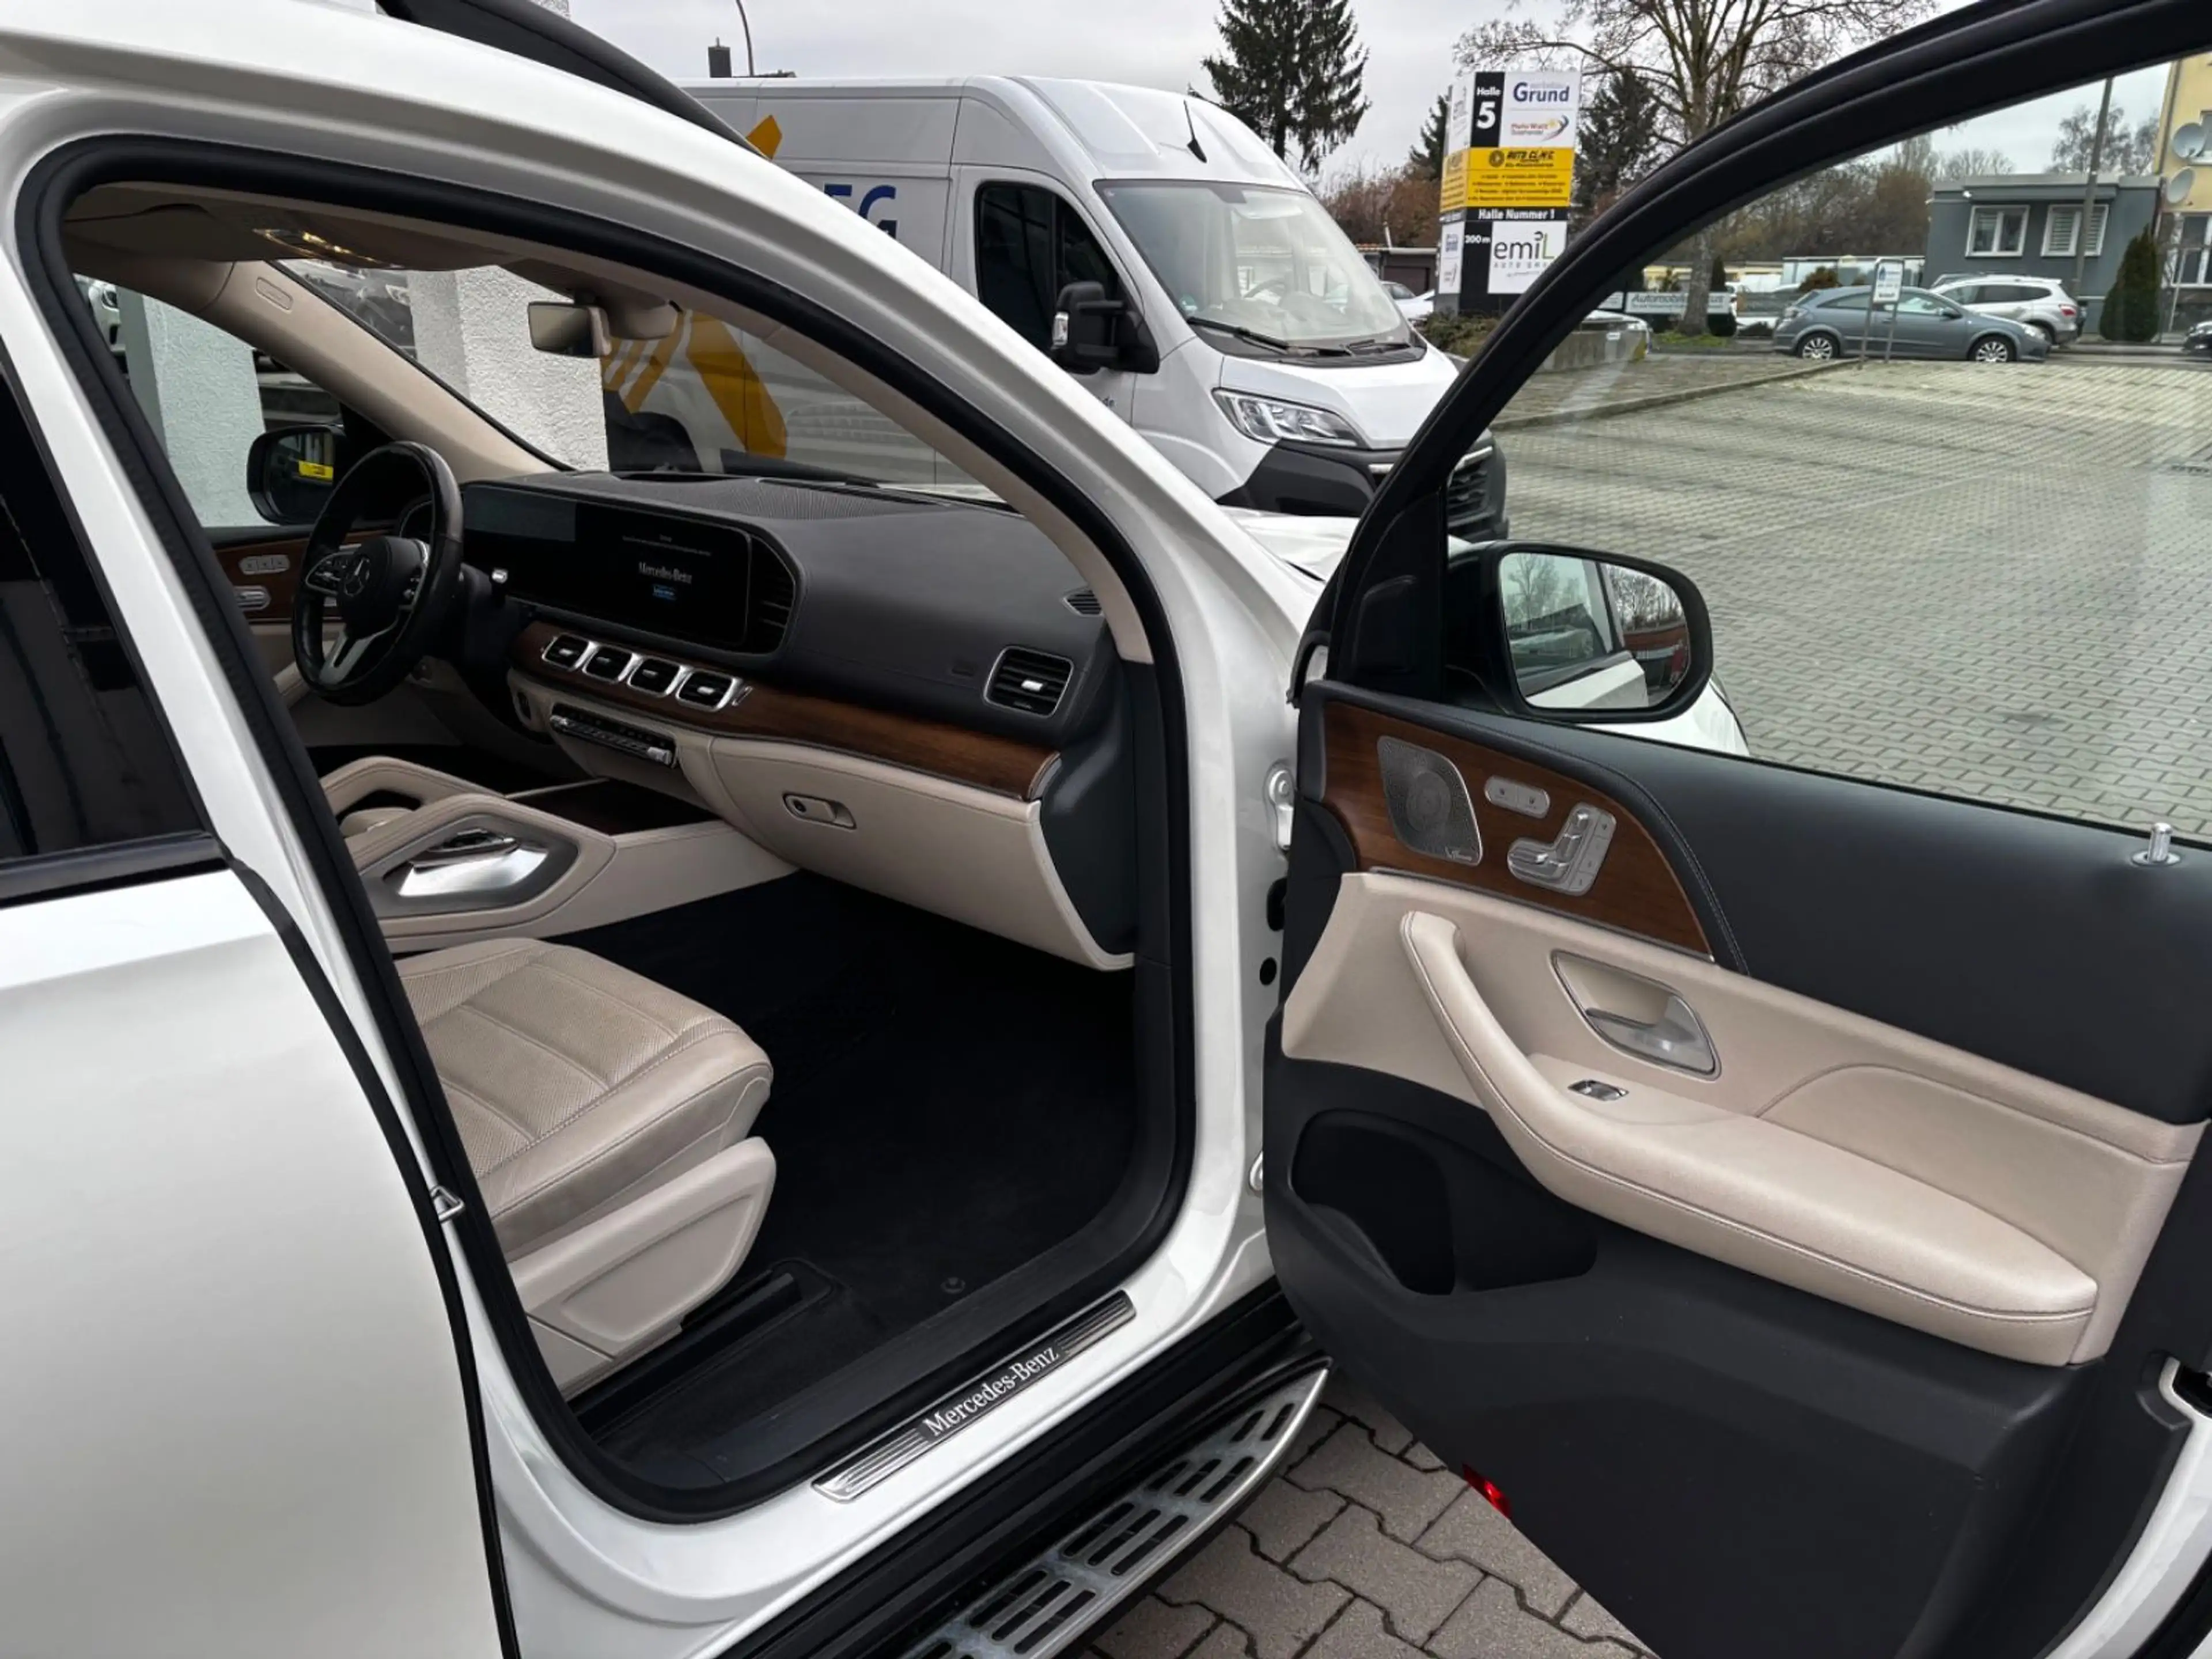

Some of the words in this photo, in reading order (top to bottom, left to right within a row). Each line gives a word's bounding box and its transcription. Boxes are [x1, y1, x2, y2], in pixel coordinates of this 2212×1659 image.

[1476, 86, 1501, 96] Halle
[1513, 82, 1570, 103] Grund
[1476, 101, 1496, 130] 5
[1478, 209, 1505, 219] Halle
[1506, 209, 1548, 219] Nummer
[923, 1346, 1059, 1437] Mercedes-Benz
